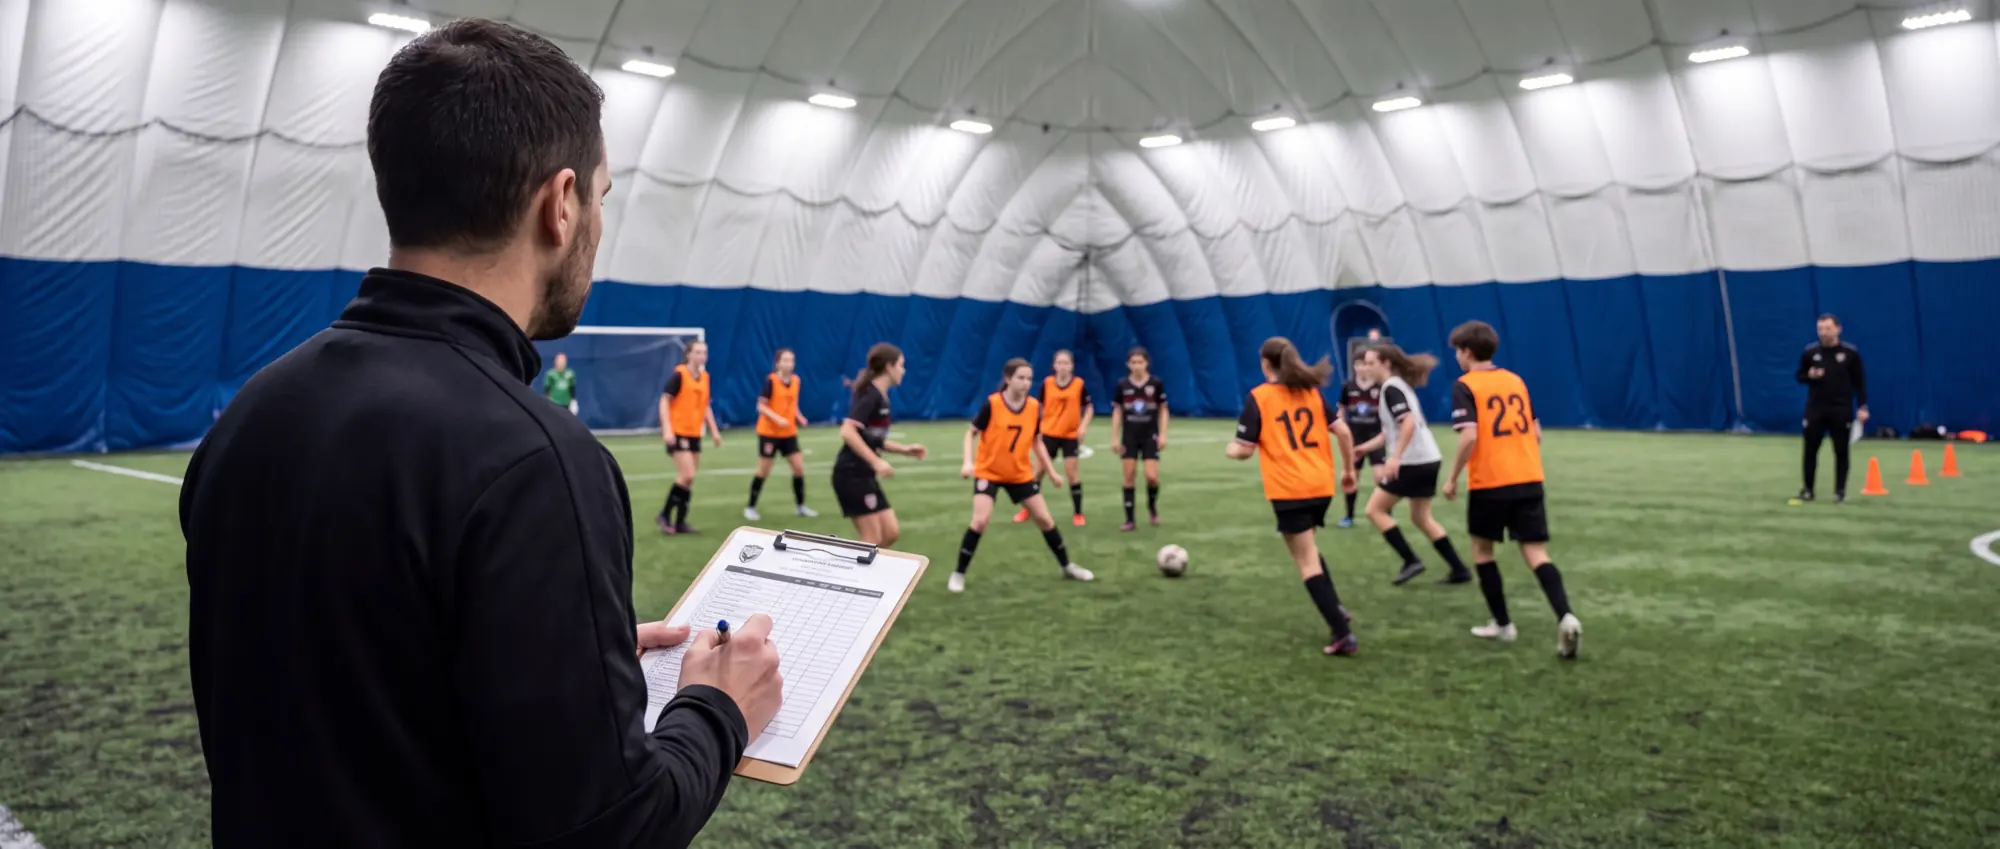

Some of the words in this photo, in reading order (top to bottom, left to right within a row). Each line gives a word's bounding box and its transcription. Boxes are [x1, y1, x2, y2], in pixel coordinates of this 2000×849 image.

[1275, 407, 1319, 451] 12
[1487, 394, 1529, 437] 23
[1007, 425, 1022, 453] 7
